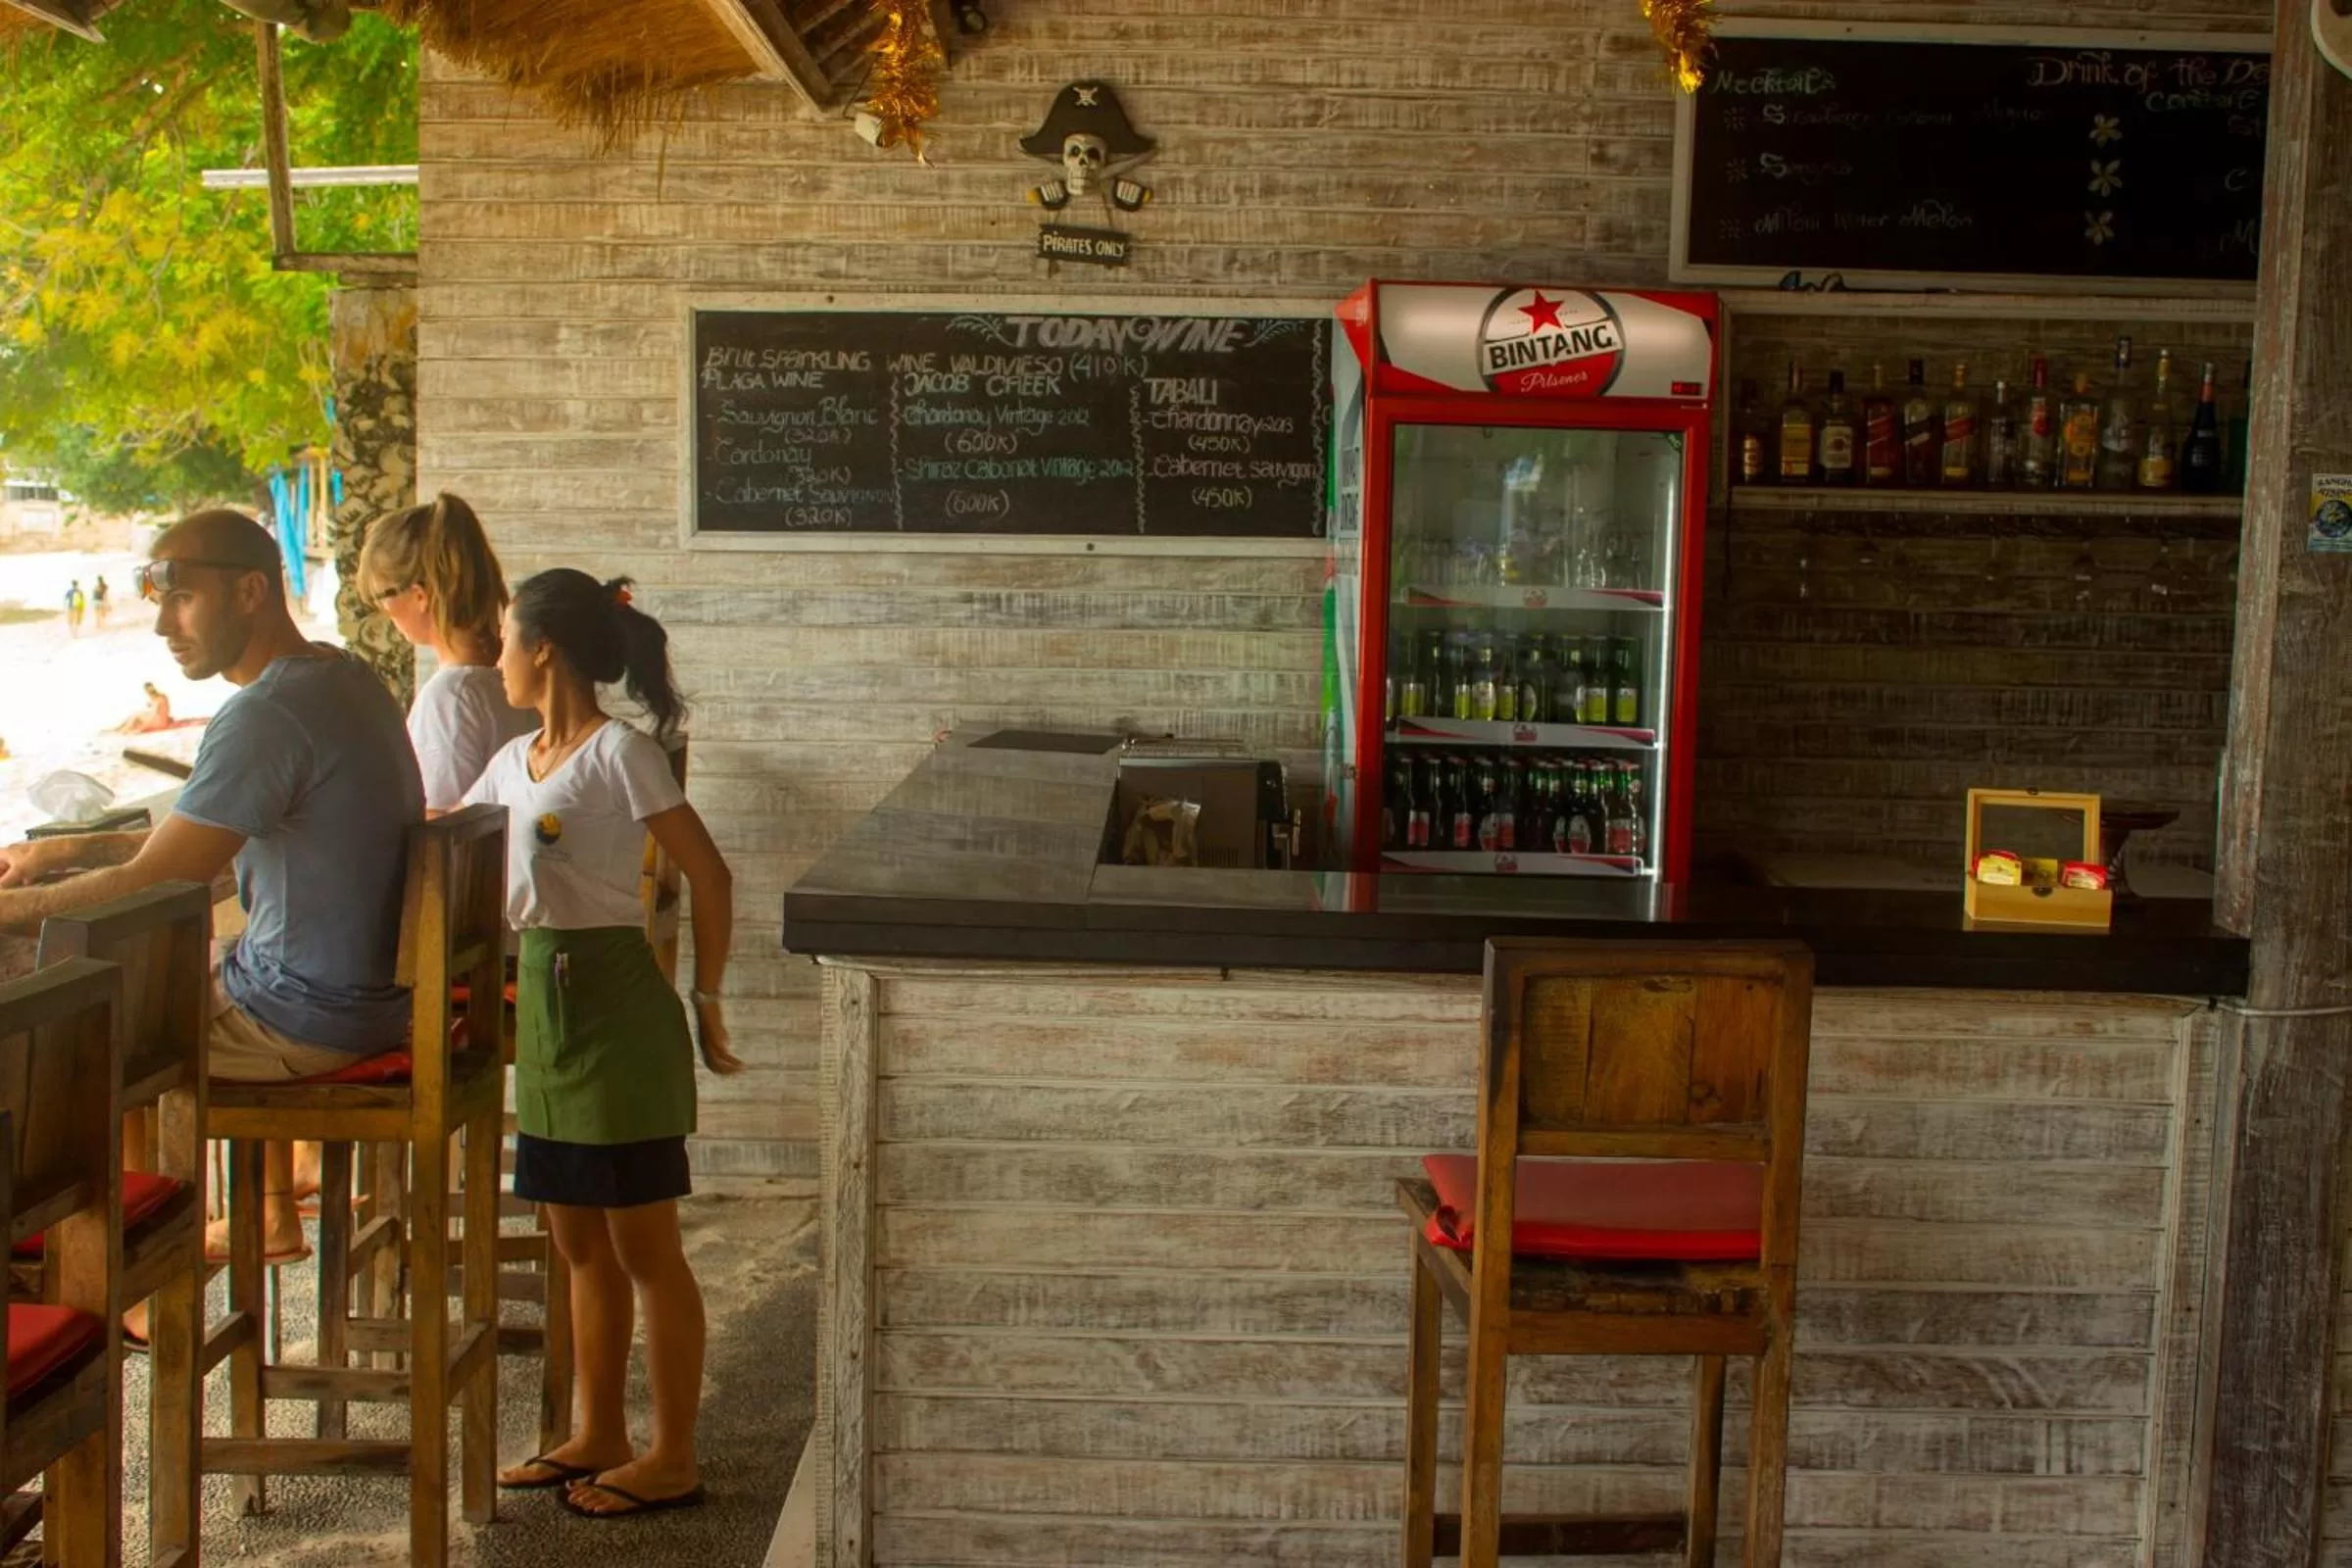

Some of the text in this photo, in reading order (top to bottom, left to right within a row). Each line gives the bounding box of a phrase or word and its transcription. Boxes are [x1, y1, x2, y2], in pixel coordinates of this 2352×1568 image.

[2019, 51, 2119, 87] Drink
[2123, 60, 2159, 94] of
[2220, 58, 2271, 86] Da
[1096, 241, 1125, 257] ONLY
[1004, 317, 1246, 354] TODAY WINE
[1489, 324, 1613, 392] BINTANG Pilsener
[770, 370, 826, 389] WINE
[904, 372, 970, 397] JACOB
